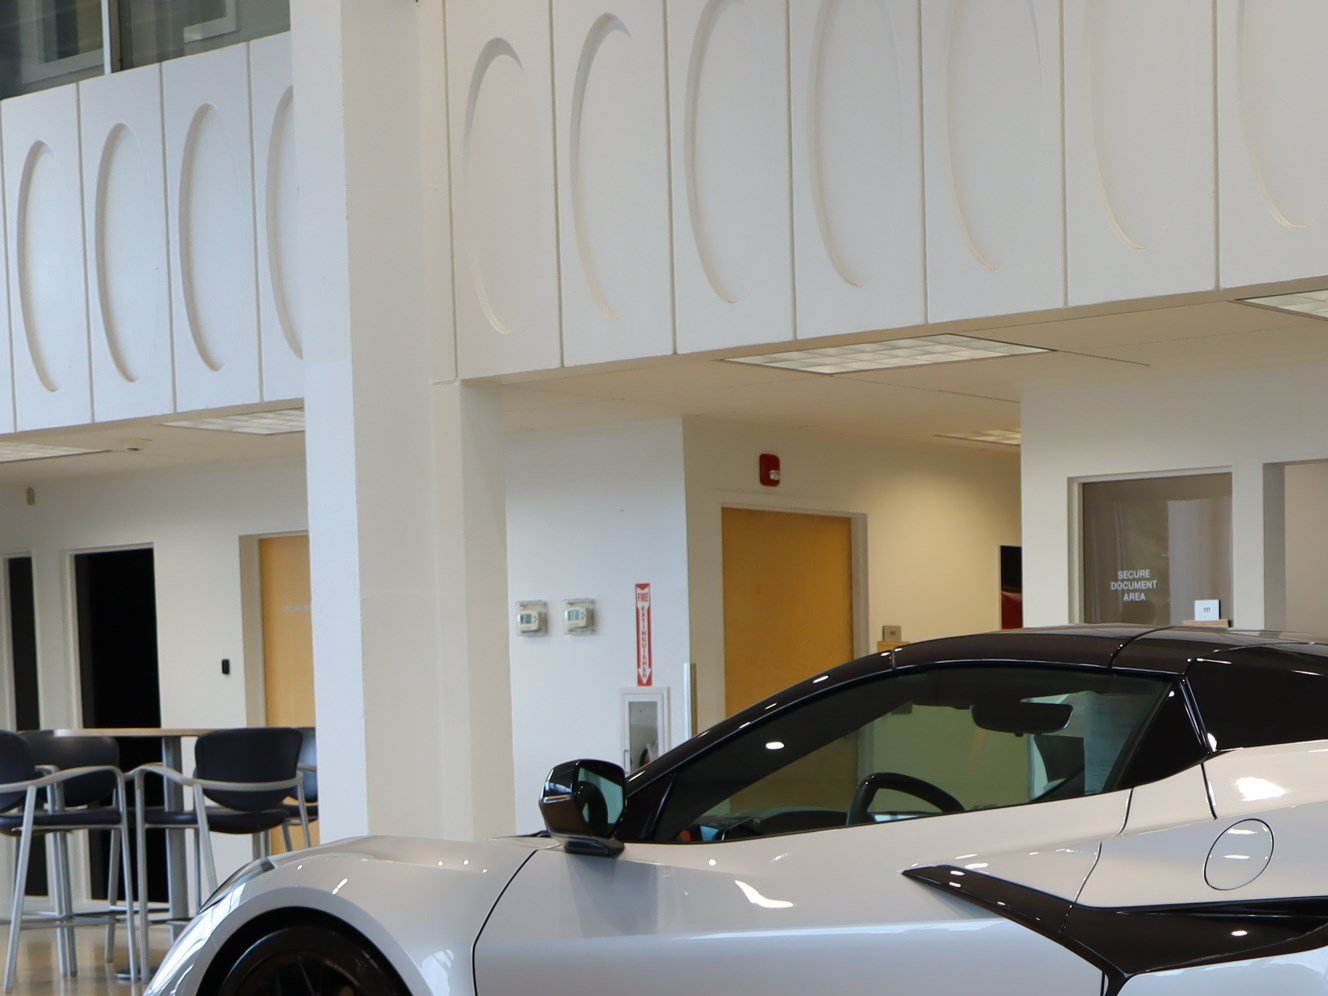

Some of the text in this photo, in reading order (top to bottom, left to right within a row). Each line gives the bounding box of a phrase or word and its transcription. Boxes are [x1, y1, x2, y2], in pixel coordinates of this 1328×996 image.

[1118, 569, 1151, 580] SECURE
[1110, 580, 1158, 591] DOCUMENT
[637, 592, 649, 602] FIRE
[1123, 592, 1147, 602] AREA
